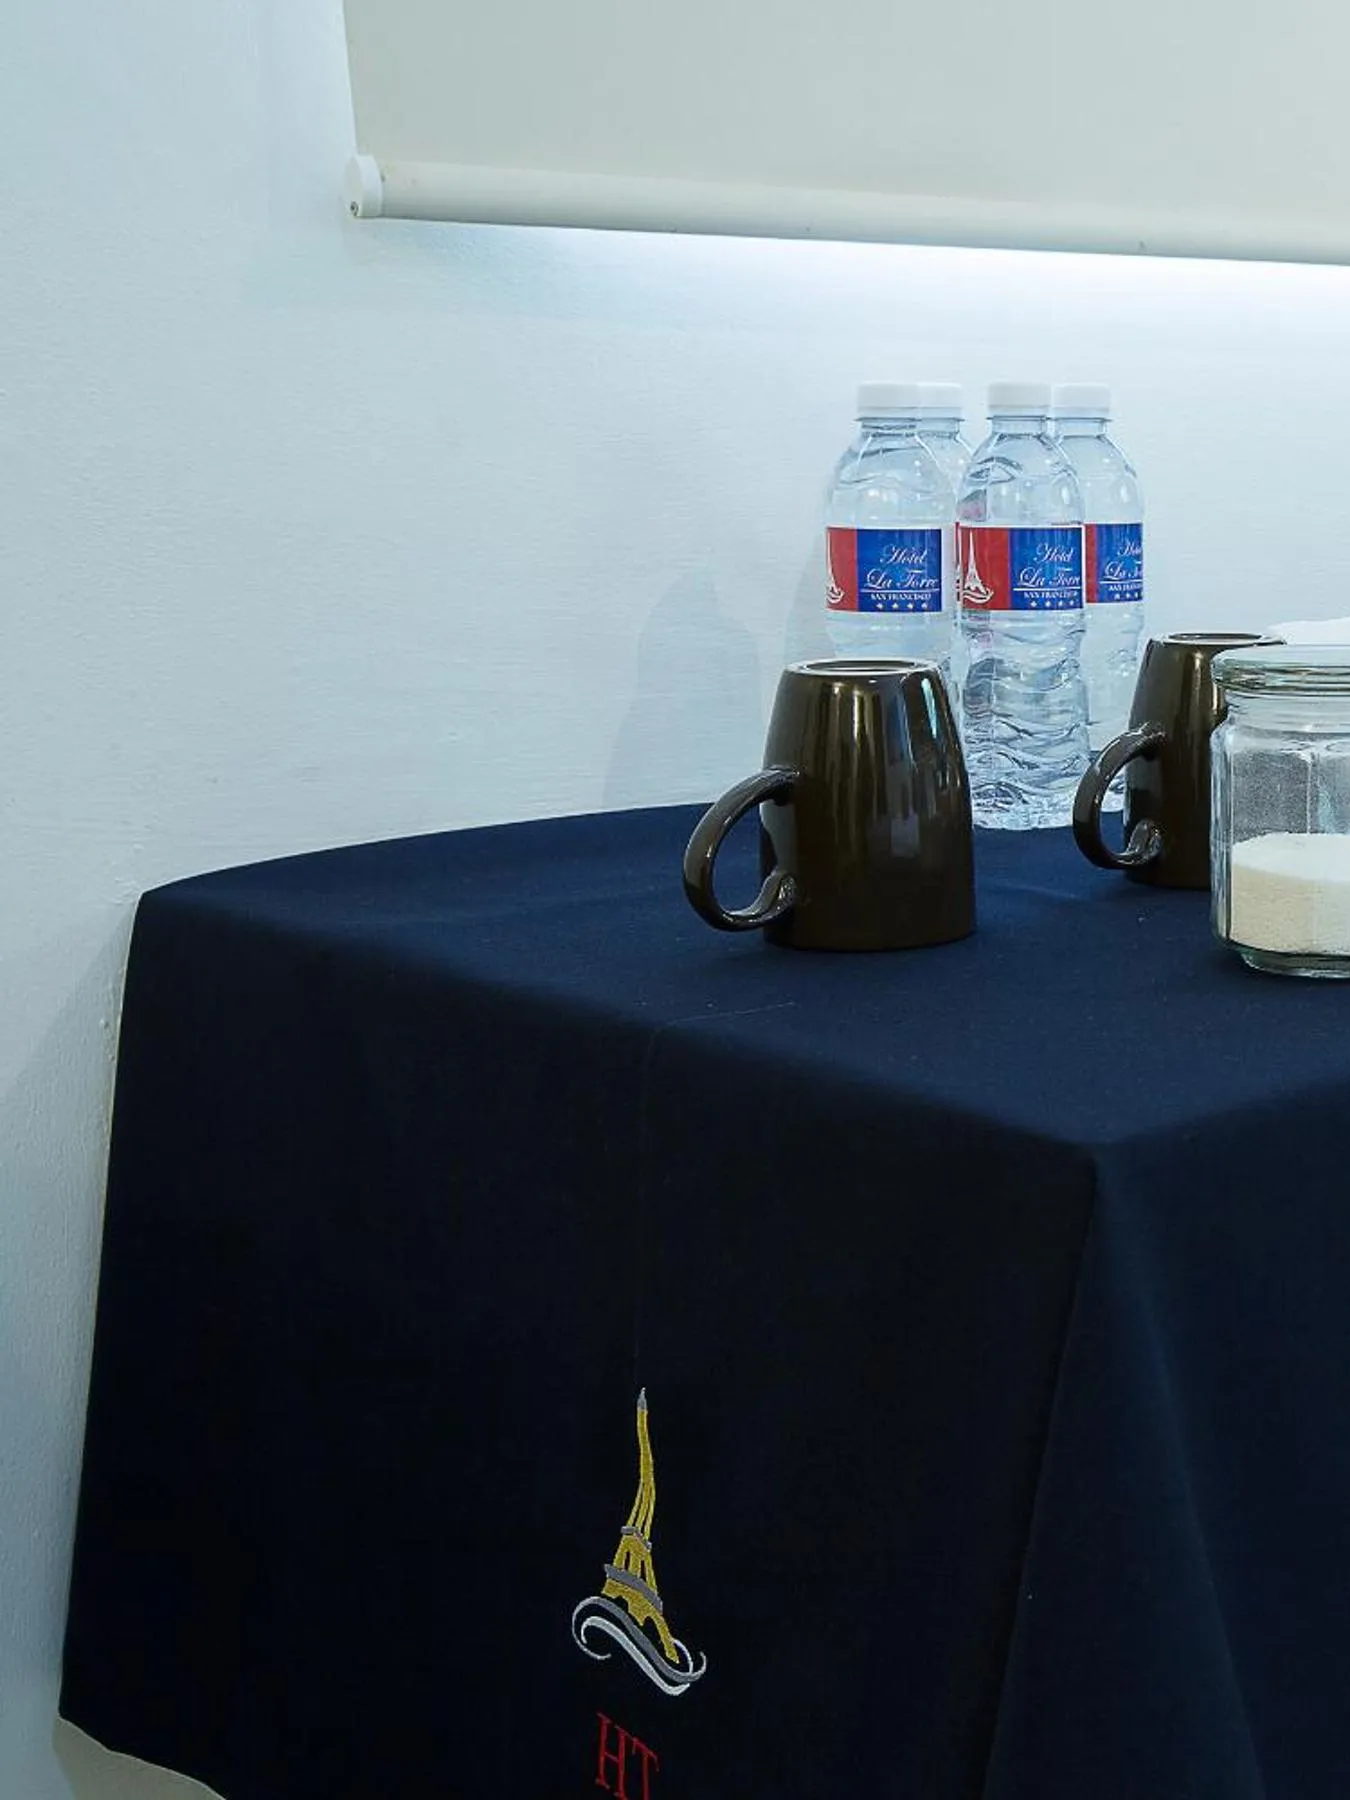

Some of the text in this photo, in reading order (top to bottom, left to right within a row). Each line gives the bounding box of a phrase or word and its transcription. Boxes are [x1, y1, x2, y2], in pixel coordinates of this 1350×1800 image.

[880, 544, 928, 565] Hotel
[1033, 542, 1074, 563] Hotel
[864, 568, 894, 589] La
[1019, 566, 1046, 587] La
[1104, 561, 1127, 580] La
[595, 1711, 660, 1800] HT
